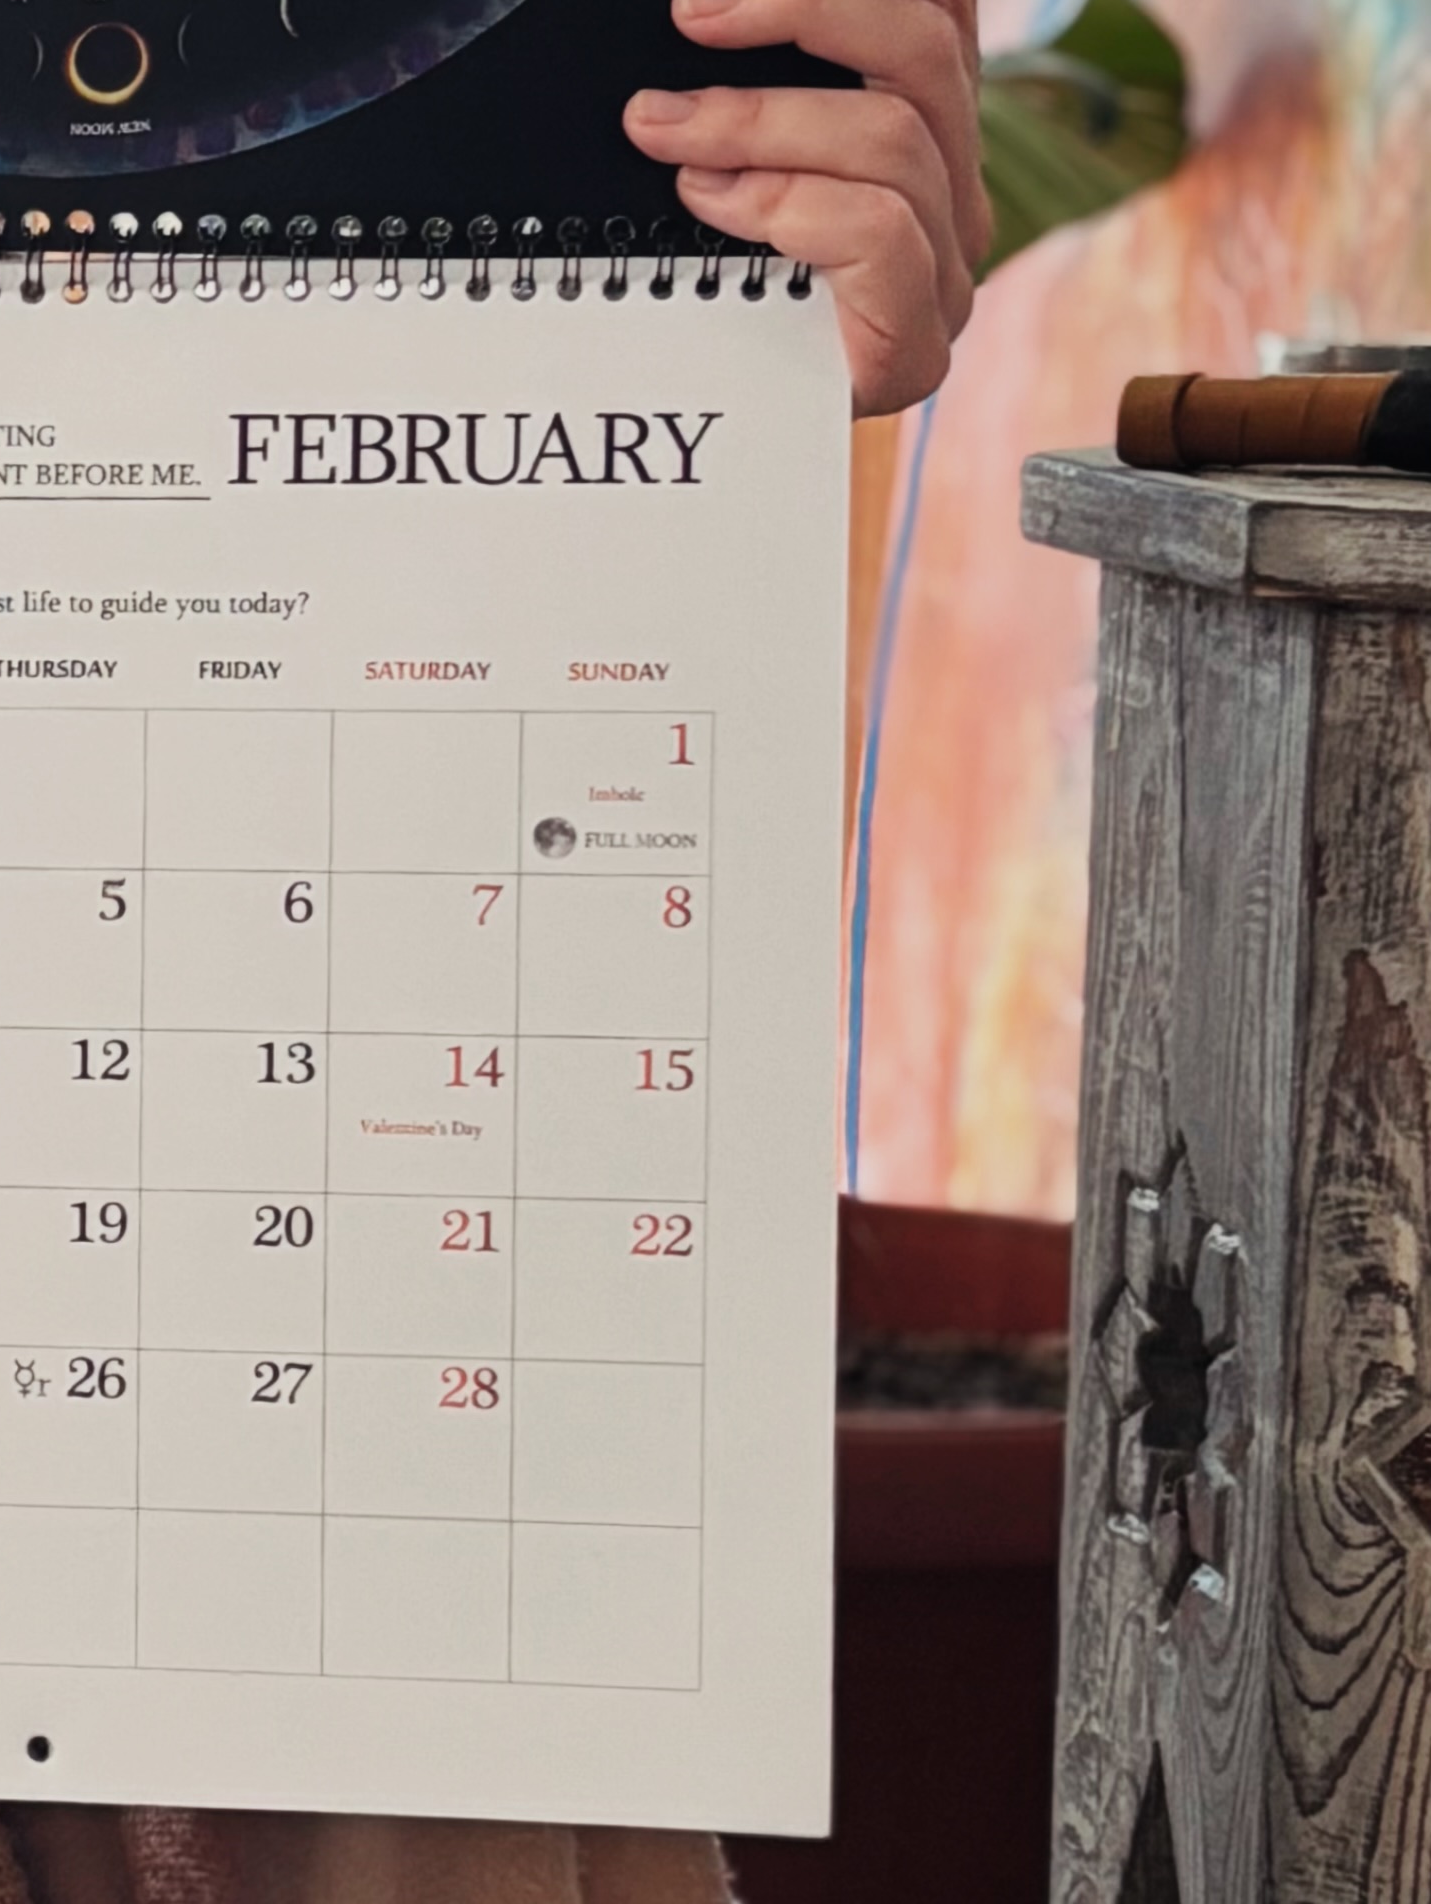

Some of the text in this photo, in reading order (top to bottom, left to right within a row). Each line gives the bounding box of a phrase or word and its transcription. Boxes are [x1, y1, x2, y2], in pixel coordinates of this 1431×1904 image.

[228, 413, 723, 485] FEBRUARY
[36, 463, 143, 485] BEFORE
[152, 464, 201, 485] ME.
[24, 590, 61, 613] life
[70, 597, 93, 613] to
[100, 591, 167, 620] guide
[176, 599, 220, 620] you
[230, 592, 309, 620] today?
[200, 661, 281, 679] FRIDAY
[365, 662, 491, 680] SATURDAY
[568, 662, 669, 681] SUNDAY
[670, 724, 694, 765] 1
[585, 832, 697, 848] FULL MOON
[99, 879, 126, 920] 5
[285, 881, 313, 923] 6
[473, 884, 504, 925] 7
[664, 886, 692, 928] 8
[73, 1039, 129, 1080] 12
[258, 1042, 315, 1084] 13
[446, 1046, 504, 1087] 14
[636, 1049, 694, 1091] 15
[452, 1121, 482, 1140] Day
[71, 1202, 127, 1243] 19
[254, 1205, 313, 1247] 20
[441, 1210, 499, 1252] 21
[631, 1214, 693, 1256] 22
[67, 1357, 126, 1398] 26
[252, 1361, 313, 1404] 27
[440, 1367, 499, 1409] 28
